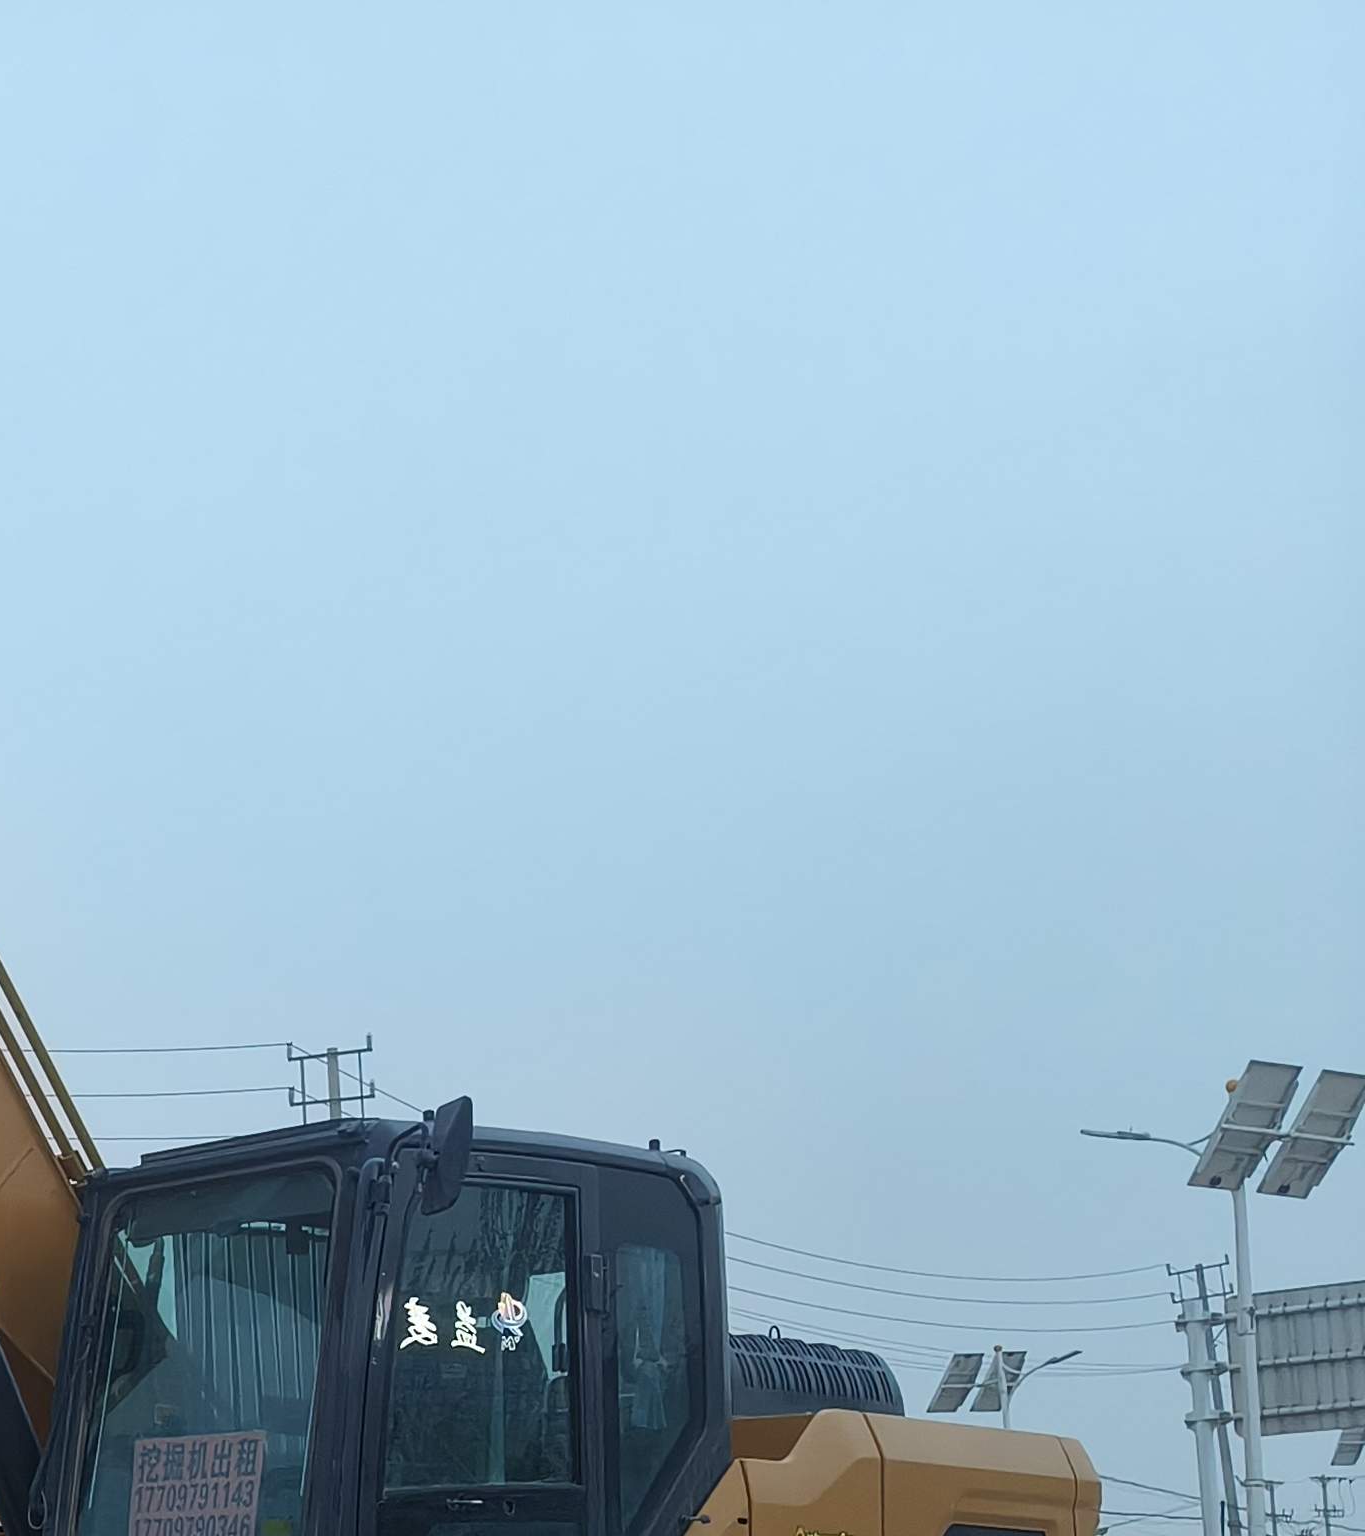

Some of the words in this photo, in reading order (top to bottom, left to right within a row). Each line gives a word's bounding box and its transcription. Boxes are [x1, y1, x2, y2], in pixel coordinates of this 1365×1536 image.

[138, 1438, 258, 1483] 挖掘机出租
[134, 1480, 254, 1514] 17709791143
